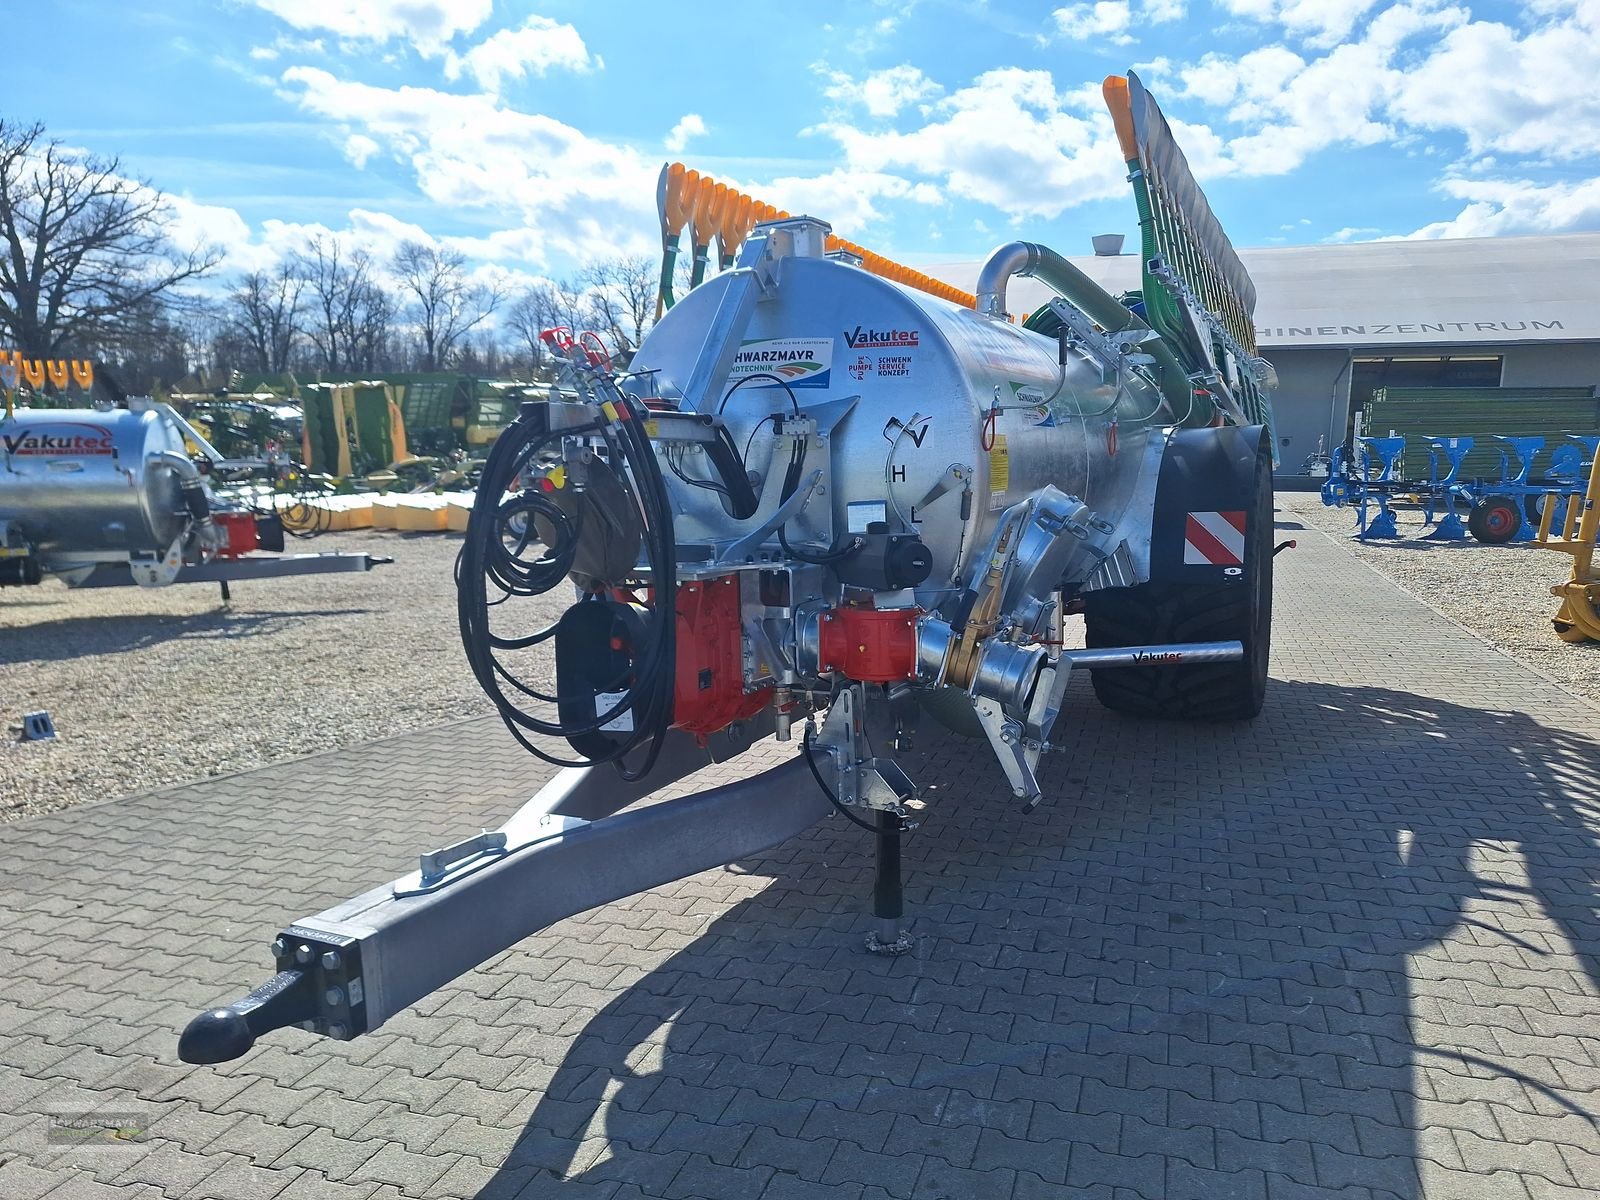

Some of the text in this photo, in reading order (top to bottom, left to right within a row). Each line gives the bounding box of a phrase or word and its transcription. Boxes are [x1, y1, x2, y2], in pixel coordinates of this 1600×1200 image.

[843, 325, 919, 349] Vakutec
[878, 356, 912, 364] SCHWENK
[3, 429, 112, 455] Vakutec
[892, 464, 906, 482] H
[911, 506, 923, 523] L
[1132, 650, 1182, 664] Vakutec
